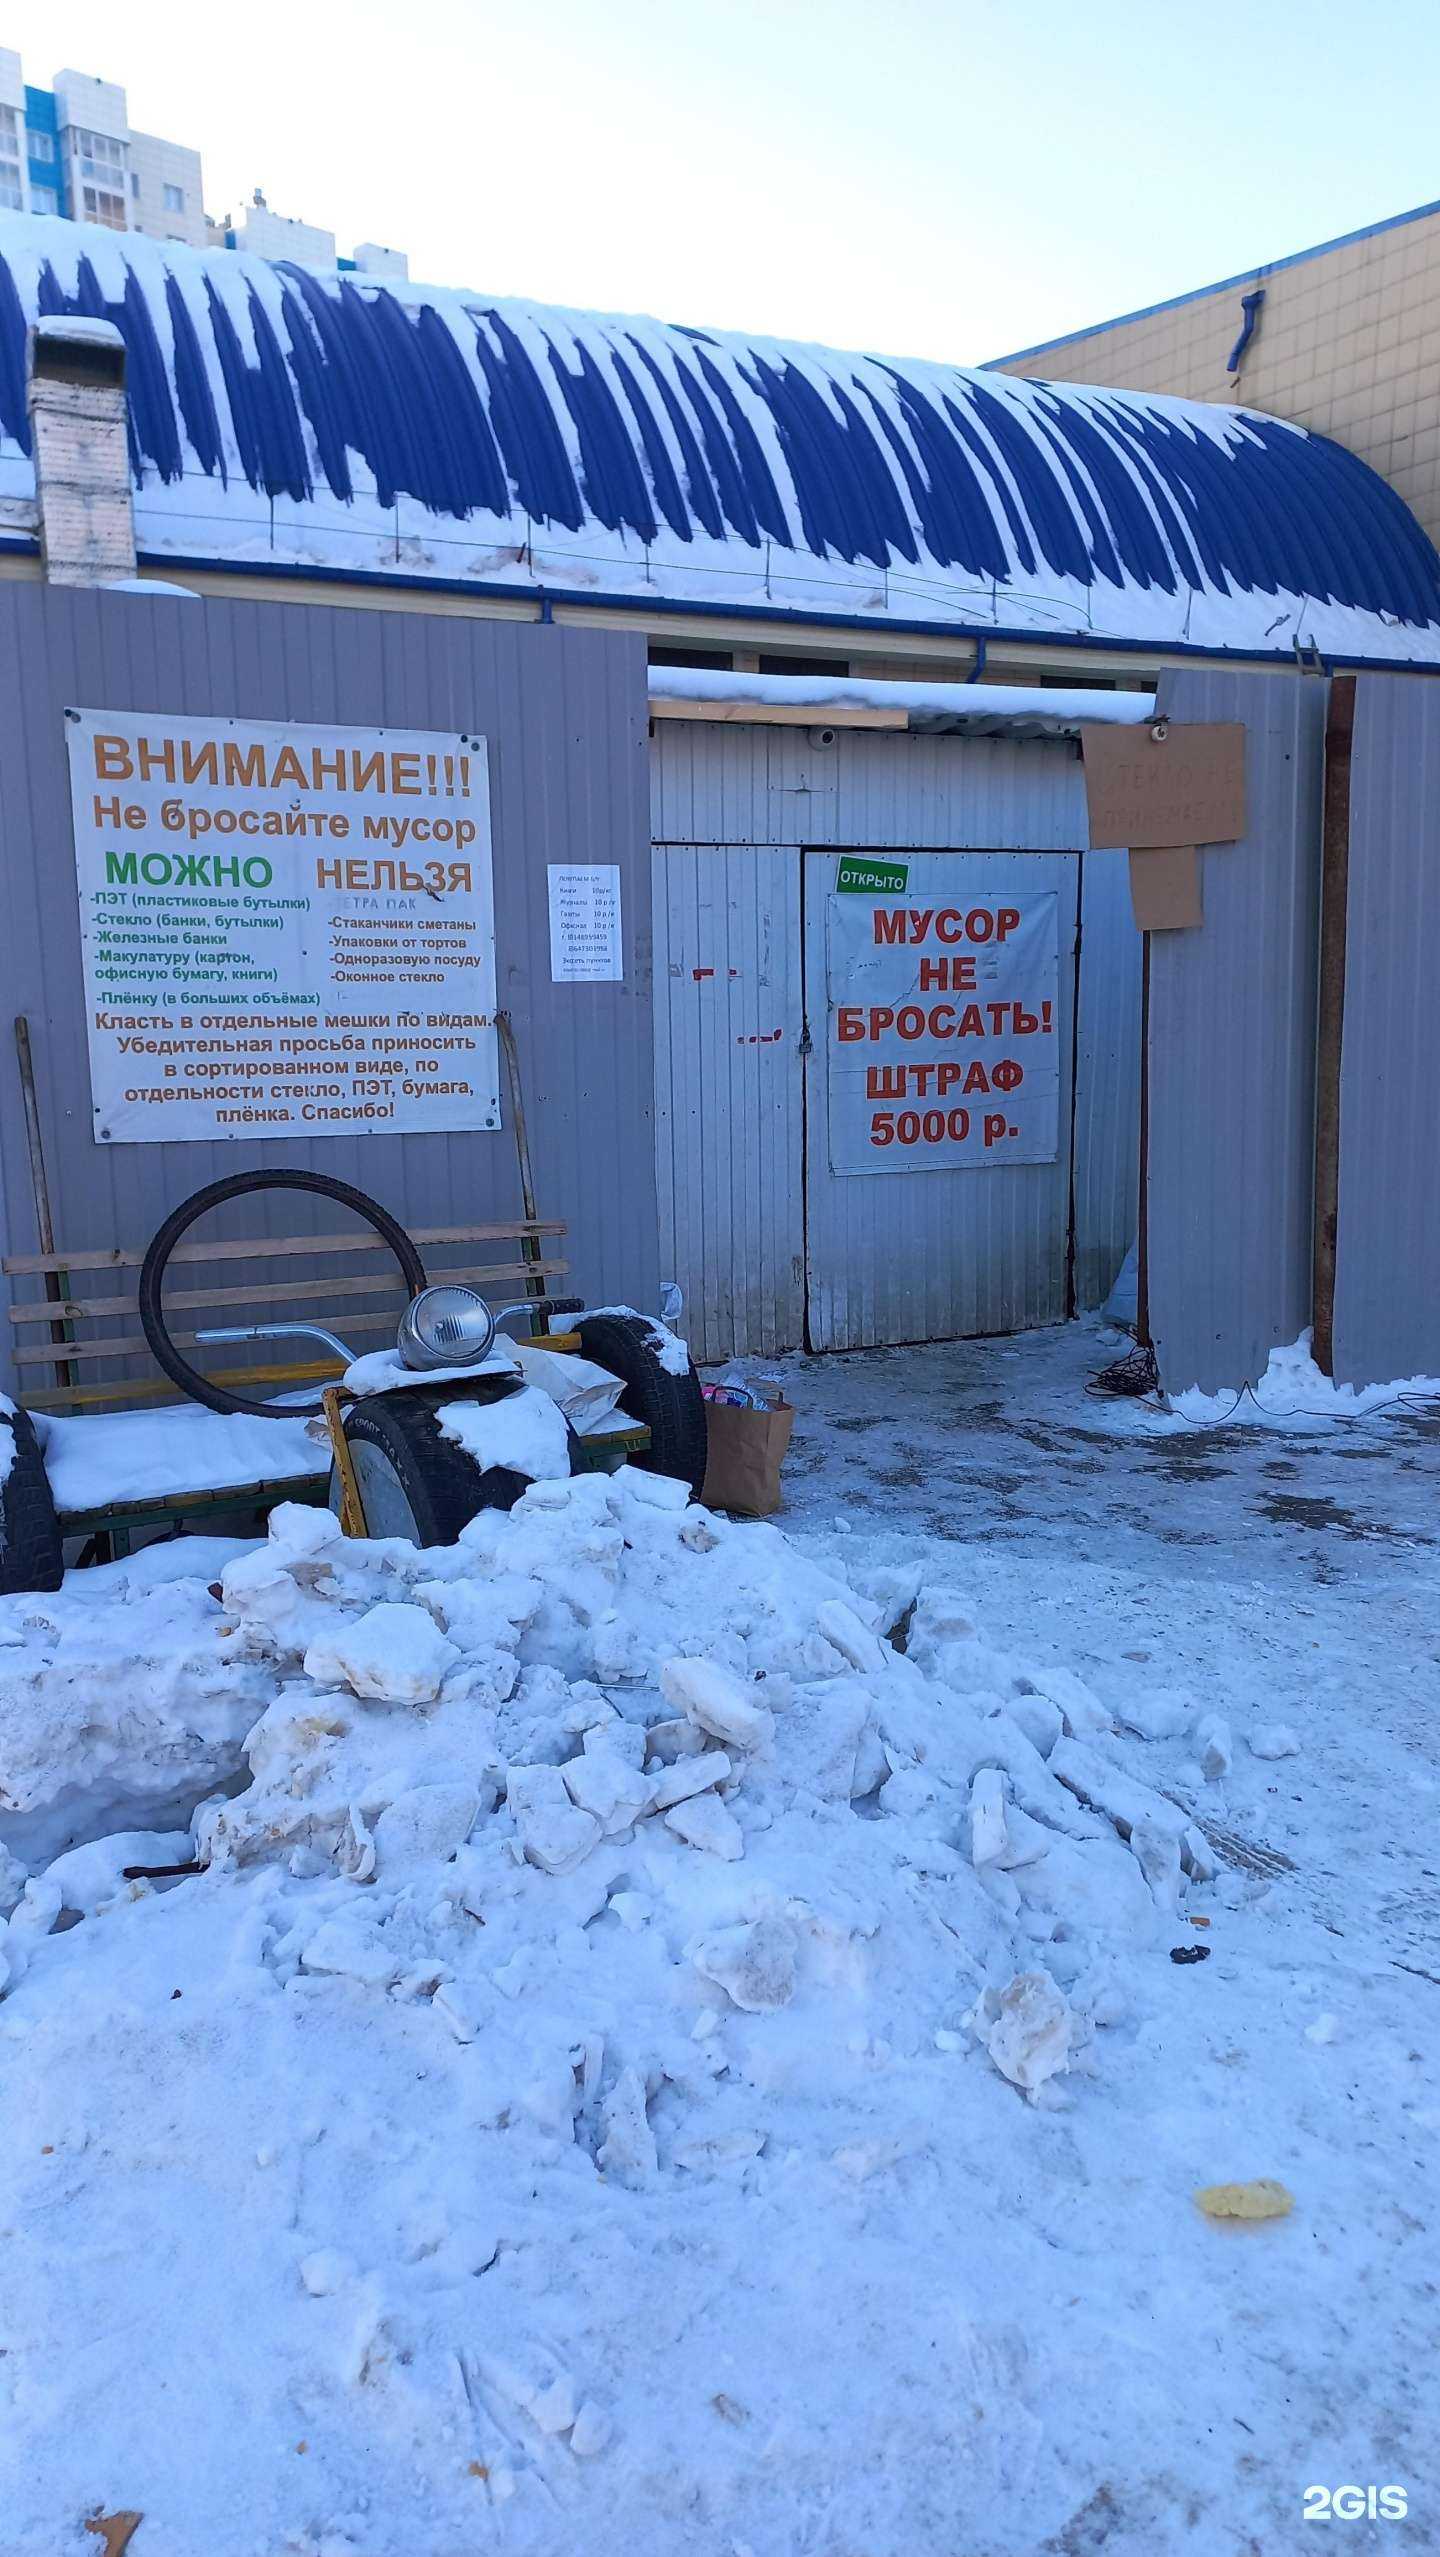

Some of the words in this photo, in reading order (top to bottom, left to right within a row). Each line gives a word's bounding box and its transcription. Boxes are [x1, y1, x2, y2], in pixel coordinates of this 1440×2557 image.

[93, 735, 470, 797] ВНИМАНИЕ!!!
[94, 796, 147, 829] Не
[161, 799, 349, 839] бросайте
[363, 816, 476, 849] мусор
[105, 852, 273, 888] МОЖНО
[317, 858, 472, 892] НЕЛЬЗЯ
[840, 869, 904, 890] ОТКРЫТО
[90, 892, 127, 905] -ПЭТ
[132, 893, 239, 908] (пластиковые
[243, 896, 312, 912] бутылки)
[91, 912, 152, 926] -Стекло
[156, 914, 211, 928] (банки,
[215, 915, 285, 930] бутылки)
[327, 916, 413, 929] -Стаканчики
[417, 920, 476, 930] сметаны
[874, 908, 1020, 944] МУСОР
[93, 931, 178, 944] -Железные
[182, 932, 227, 944] банки
[328, 935, 398, 948] -Упаковки
[402, 939, 417, 948] от
[420, 939, 467, 951] тортов
[94, 950, 190, 965] -Макулатуру
[194, 951, 255, 966] (картон,
[329, 953, 430, 967] -Одноразовую
[434, 956, 481, 968] посуду
[95, 968, 168, 982] офисную
[172, 968, 228, 982] бумагу,
[232, 968, 278, 982] книги)
[330, 971, 395, 982] -Оконное
[398, 973, 445, 983] стекло
[919, 956, 977, 992] НЕ
[96, 992, 158, 1007] -Плёнку
[162, 992, 176, 1007] (в
[181, 992, 248, 1004] больших
[252, 992, 321, 1007] объёмах)
[95, 1013, 174, 1029] Класть
[180, 1016, 193, 1029] в
[200, 1014, 318, 1031] отдельные
[325, 1015, 390, 1028] мешки
[397, 1014, 420, 1028] по
[426, 1013, 492, 1030] видам.
[838, 1001, 1052, 1042] БРОСАТЬ!
[117, 1037, 273, 1056] Убедительная
[280, 1035, 365, 1055] просьба
[372, 1037, 476, 1054] приносить
[164, 1064, 177, 1077] в
[184, 1060, 349, 1079] сортированном
[355, 1060, 409, 1075] виде,
[415, 1060, 439, 1073] по
[867, 1060, 1023, 1099] ШТРАФ
[124, 1086, 263, 1103] отдельности
[270, 1082, 346, 1100] стекло,
[352, 1080, 396, 1097] ПЭТ,
[402, 1079, 474, 1098] бумага,
[216, 1106, 295, 1123] плёнка.
[302, 1102, 394, 1121] Спасибо!
[870, 1108, 970, 1146] 5000
[984, 1112, 1019, 1146] р.
